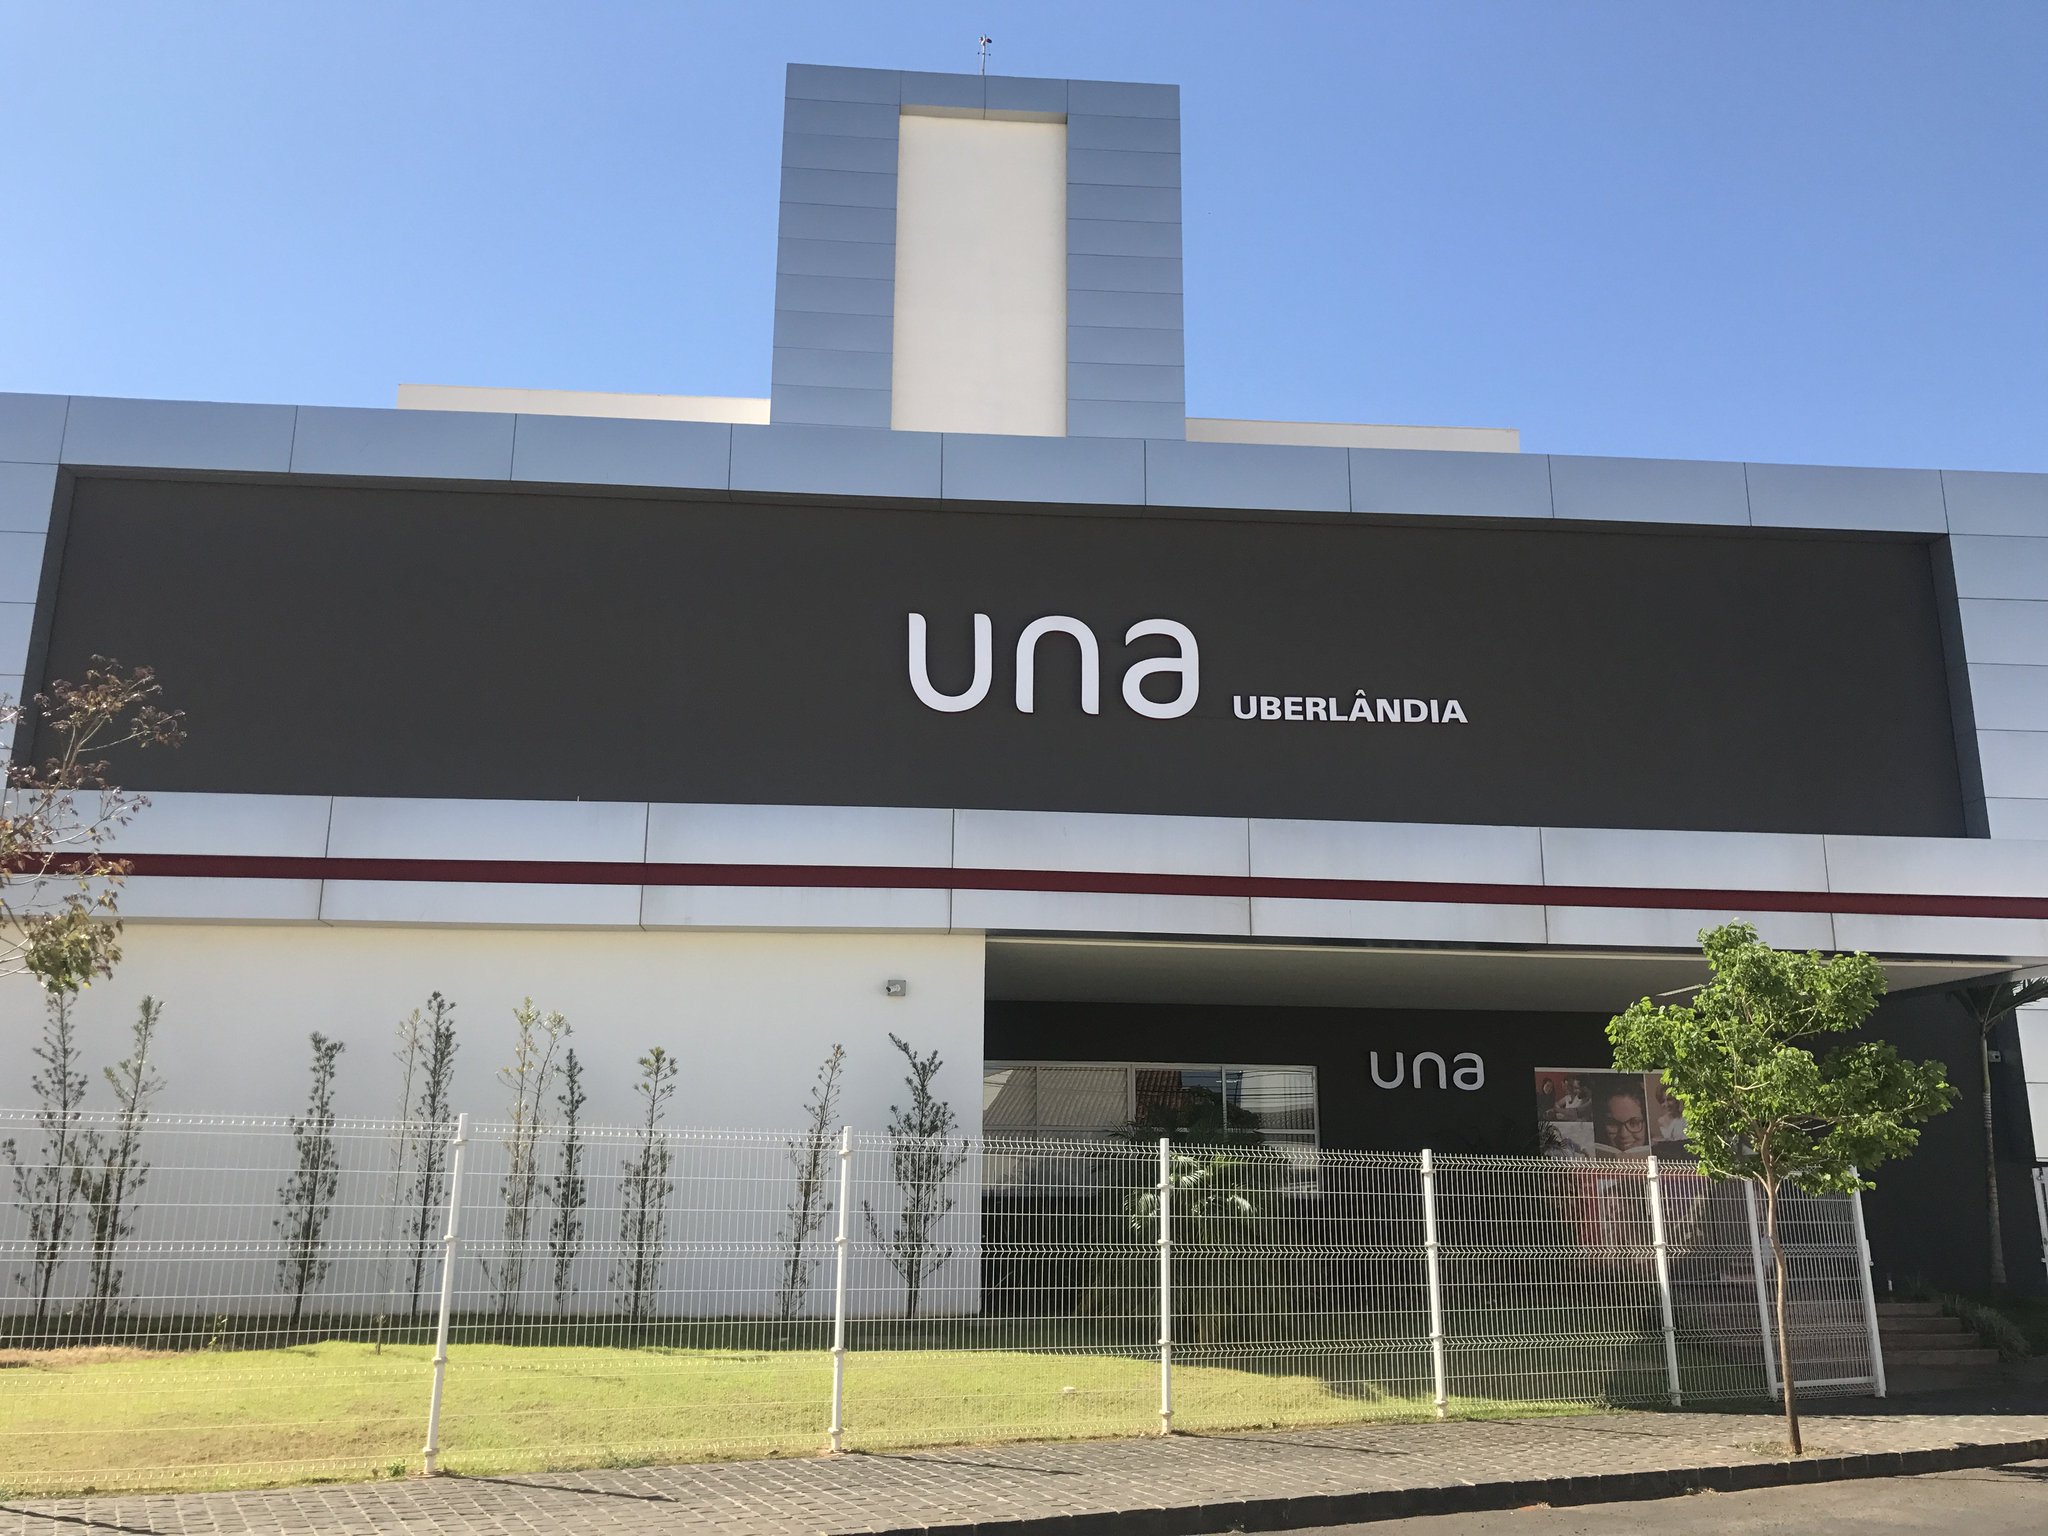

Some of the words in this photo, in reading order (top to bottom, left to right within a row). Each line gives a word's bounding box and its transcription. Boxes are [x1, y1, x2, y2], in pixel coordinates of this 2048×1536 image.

[907, 612, 1200, 720] una
[1232, 688, 1469, 724] UBERLÂNDIA
[1370, 1051, 1486, 1092] una
